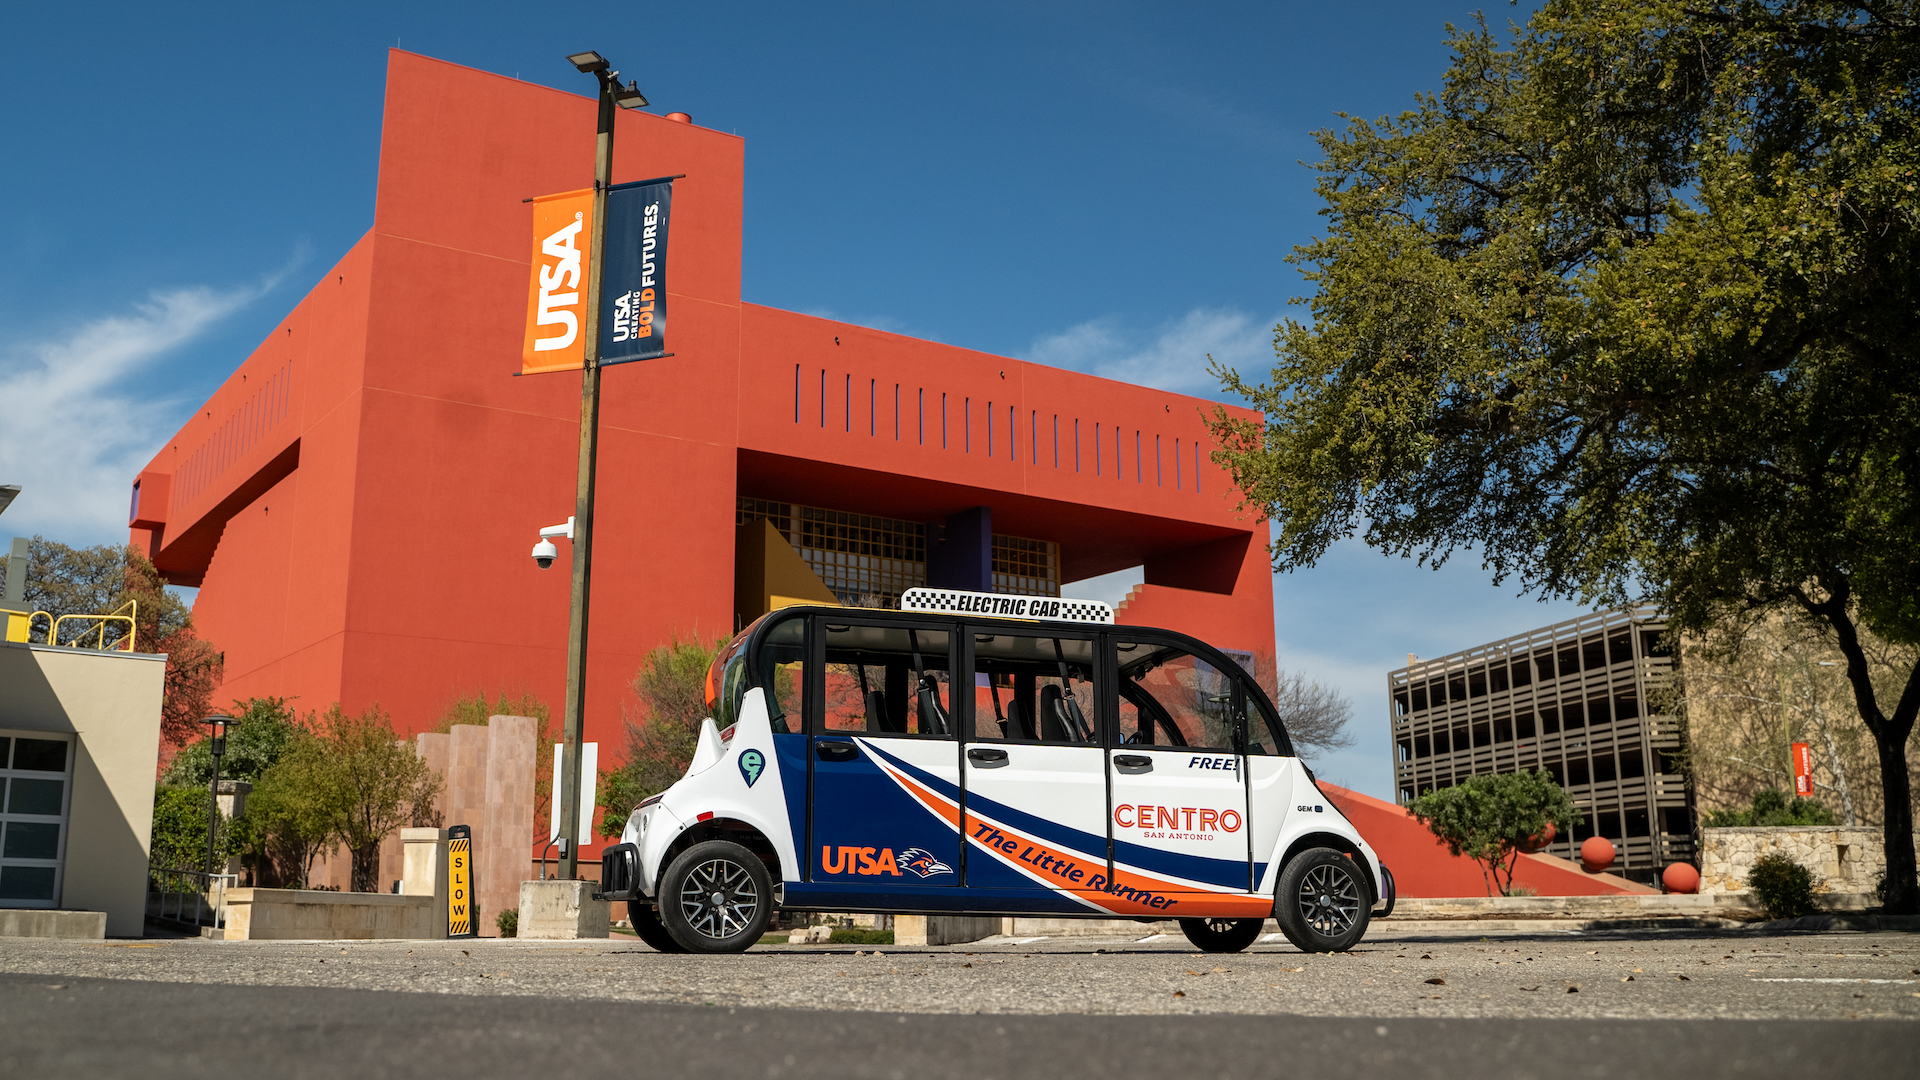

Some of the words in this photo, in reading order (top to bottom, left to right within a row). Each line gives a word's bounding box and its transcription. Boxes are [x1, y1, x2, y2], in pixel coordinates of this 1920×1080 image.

[641, 200, 660, 288] FUTURES.
[534, 218, 583, 351] UTSA
[612, 291, 632, 343] UTSA
[630, 290, 641, 340] CREATING
[638, 288, 655, 338] BOLD
[956, 595, 1026, 616] ELECTRIC
[1029, 600, 1061, 618] CAB
[1188, 756, 1240, 771] FREE!
[1114, 803, 1242, 833] CENTRO
[1143, 831, 1165, 839] SAN
[1168, 833, 1214, 841] ANTONIO
[821, 845, 900, 877] UTSA
[973, 823, 1019, 854] The
[1018, 846, 1085, 883] Little
[1085, 873, 1179, 910] Runner
[453, 857, 466, 916] SLOW
